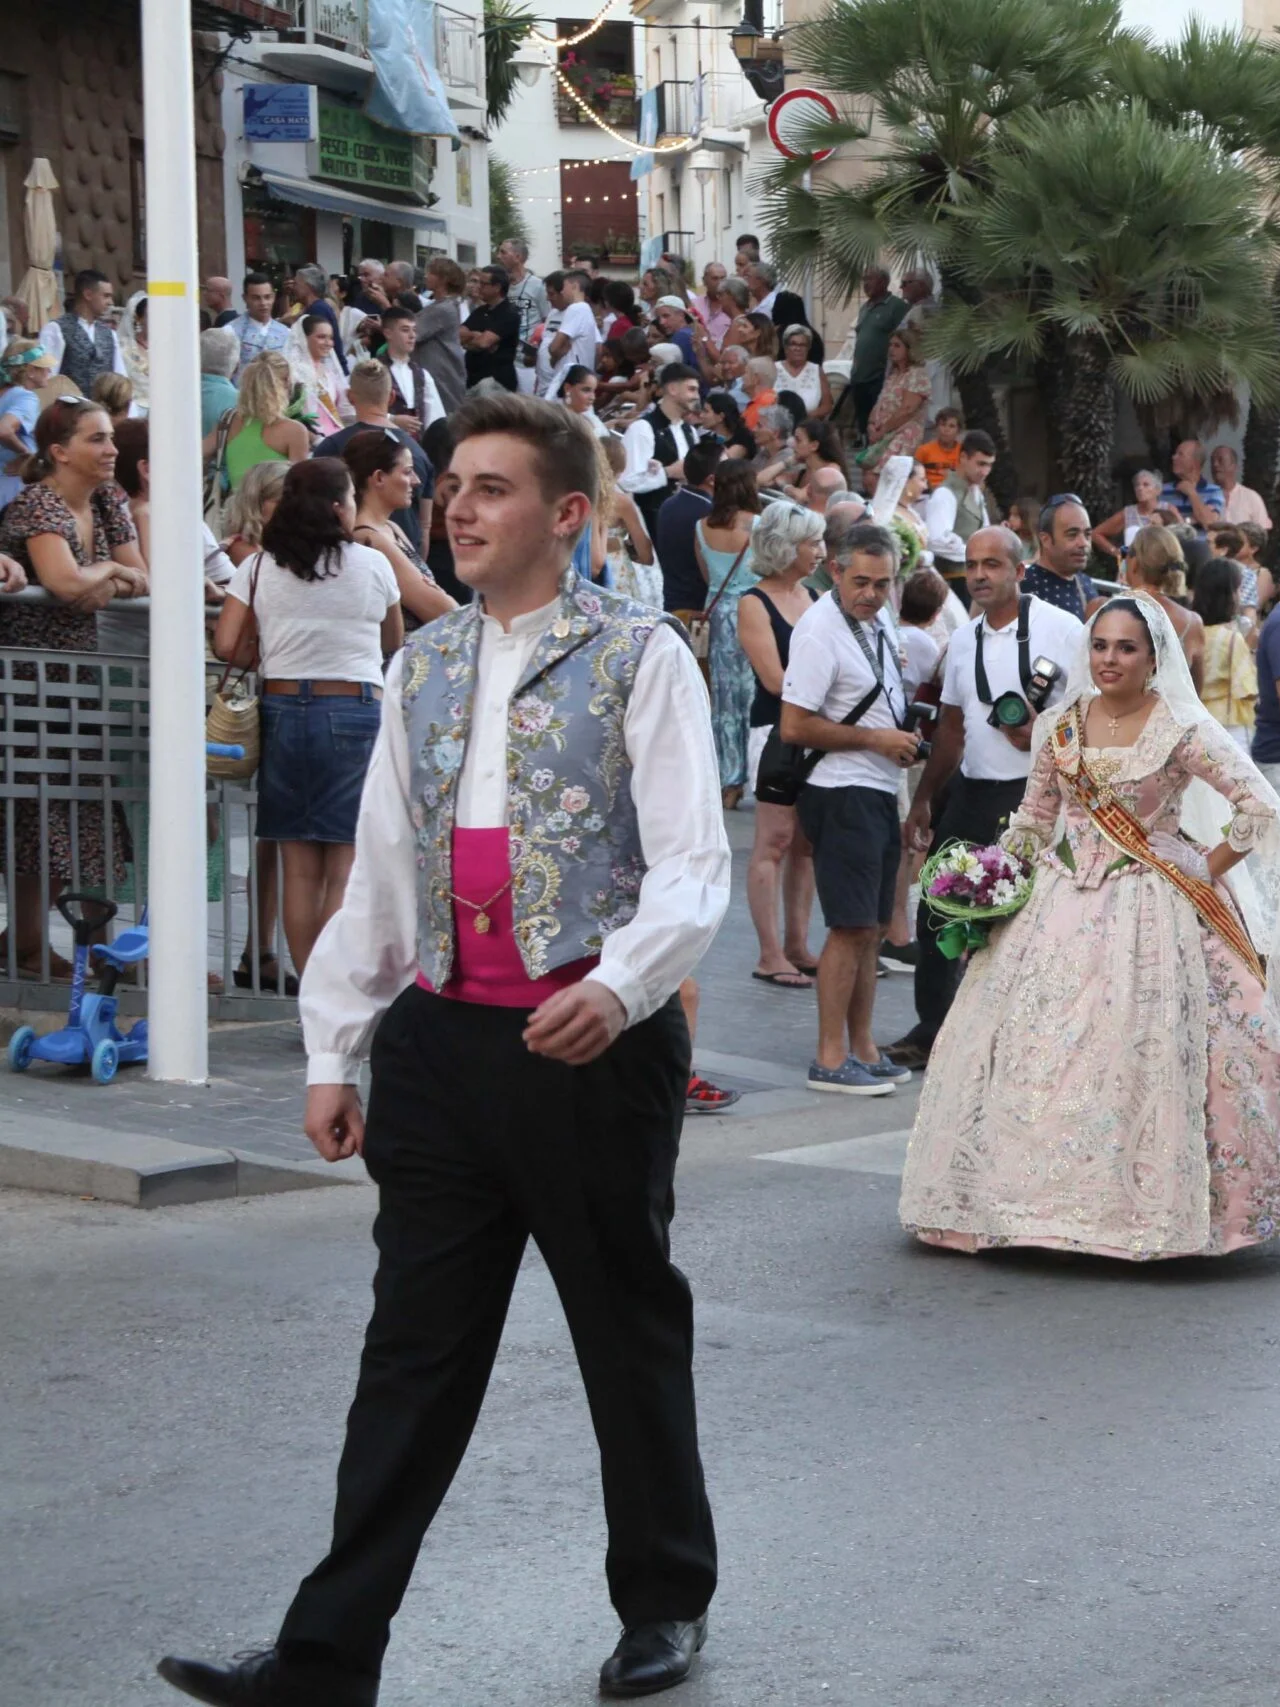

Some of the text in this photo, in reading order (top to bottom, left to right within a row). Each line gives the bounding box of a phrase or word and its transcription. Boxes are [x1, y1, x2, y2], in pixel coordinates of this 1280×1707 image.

[264, 116, 310, 124] CASA MATA
[320, 136, 348, 156] PESCA
